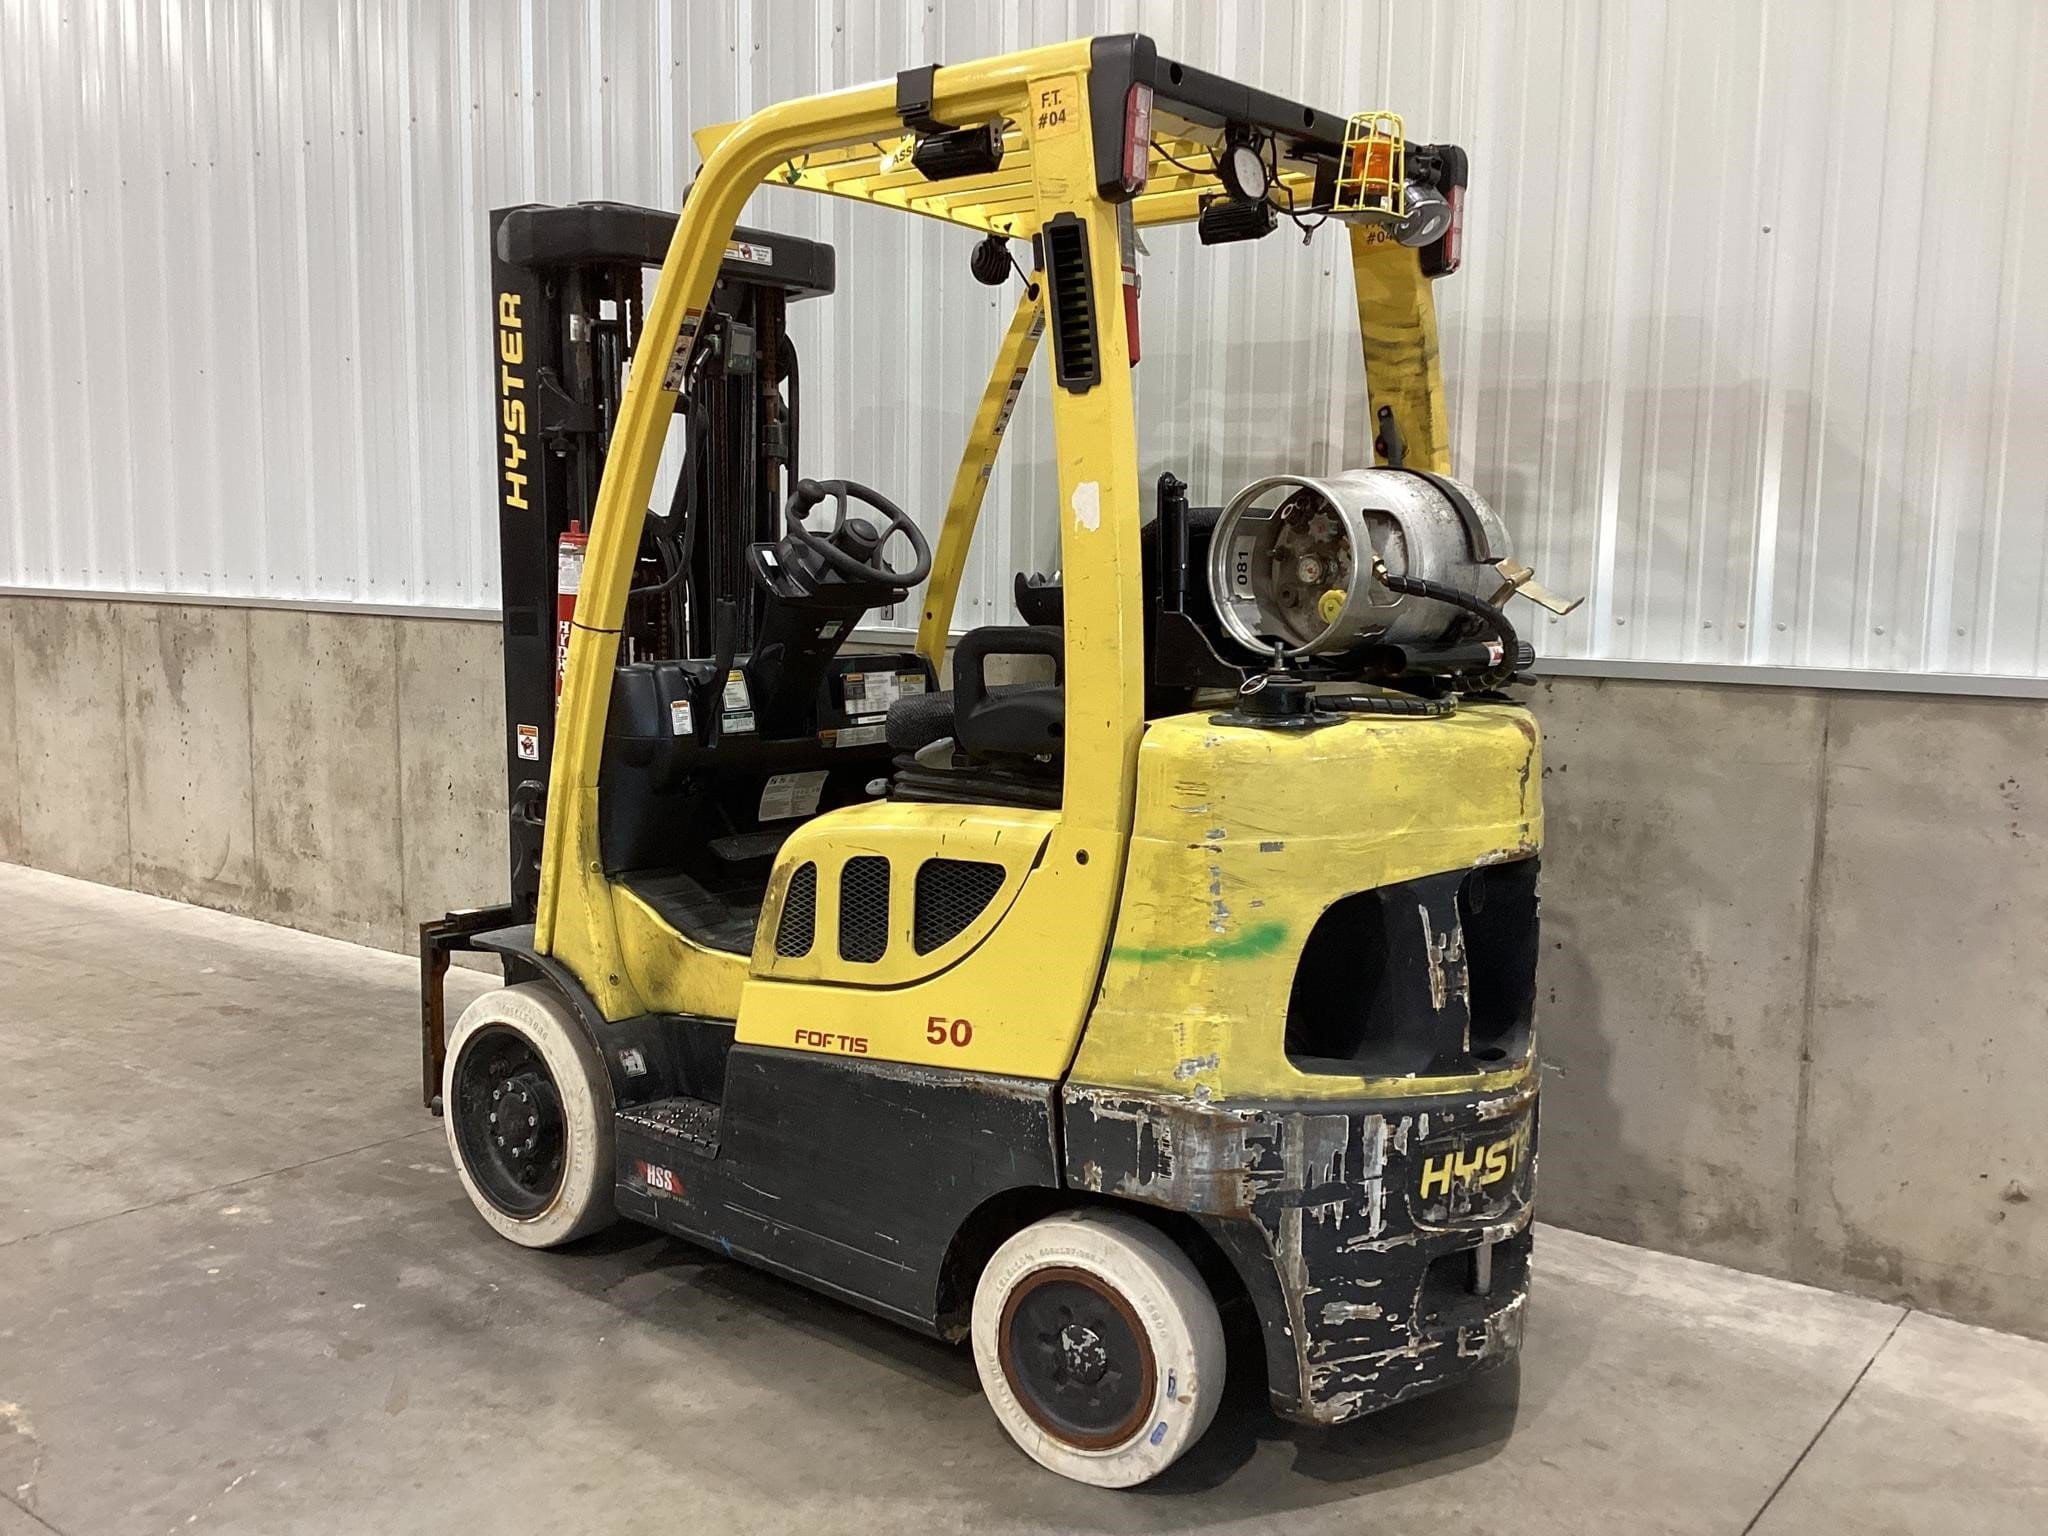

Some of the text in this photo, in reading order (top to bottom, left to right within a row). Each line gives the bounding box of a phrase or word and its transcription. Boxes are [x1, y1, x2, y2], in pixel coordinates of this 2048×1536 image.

[1041, 89, 1062, 109] F.T.
[1038, 108, 1066, 129] #04
[892, 145, 913, 167] ASS
[499, 291, 528, 511] HYSTER
[1236, 551, 1249, 586] 081
[926, 1016, 973, 1047] 50
[647, 1163, 673, 1191] HSS
